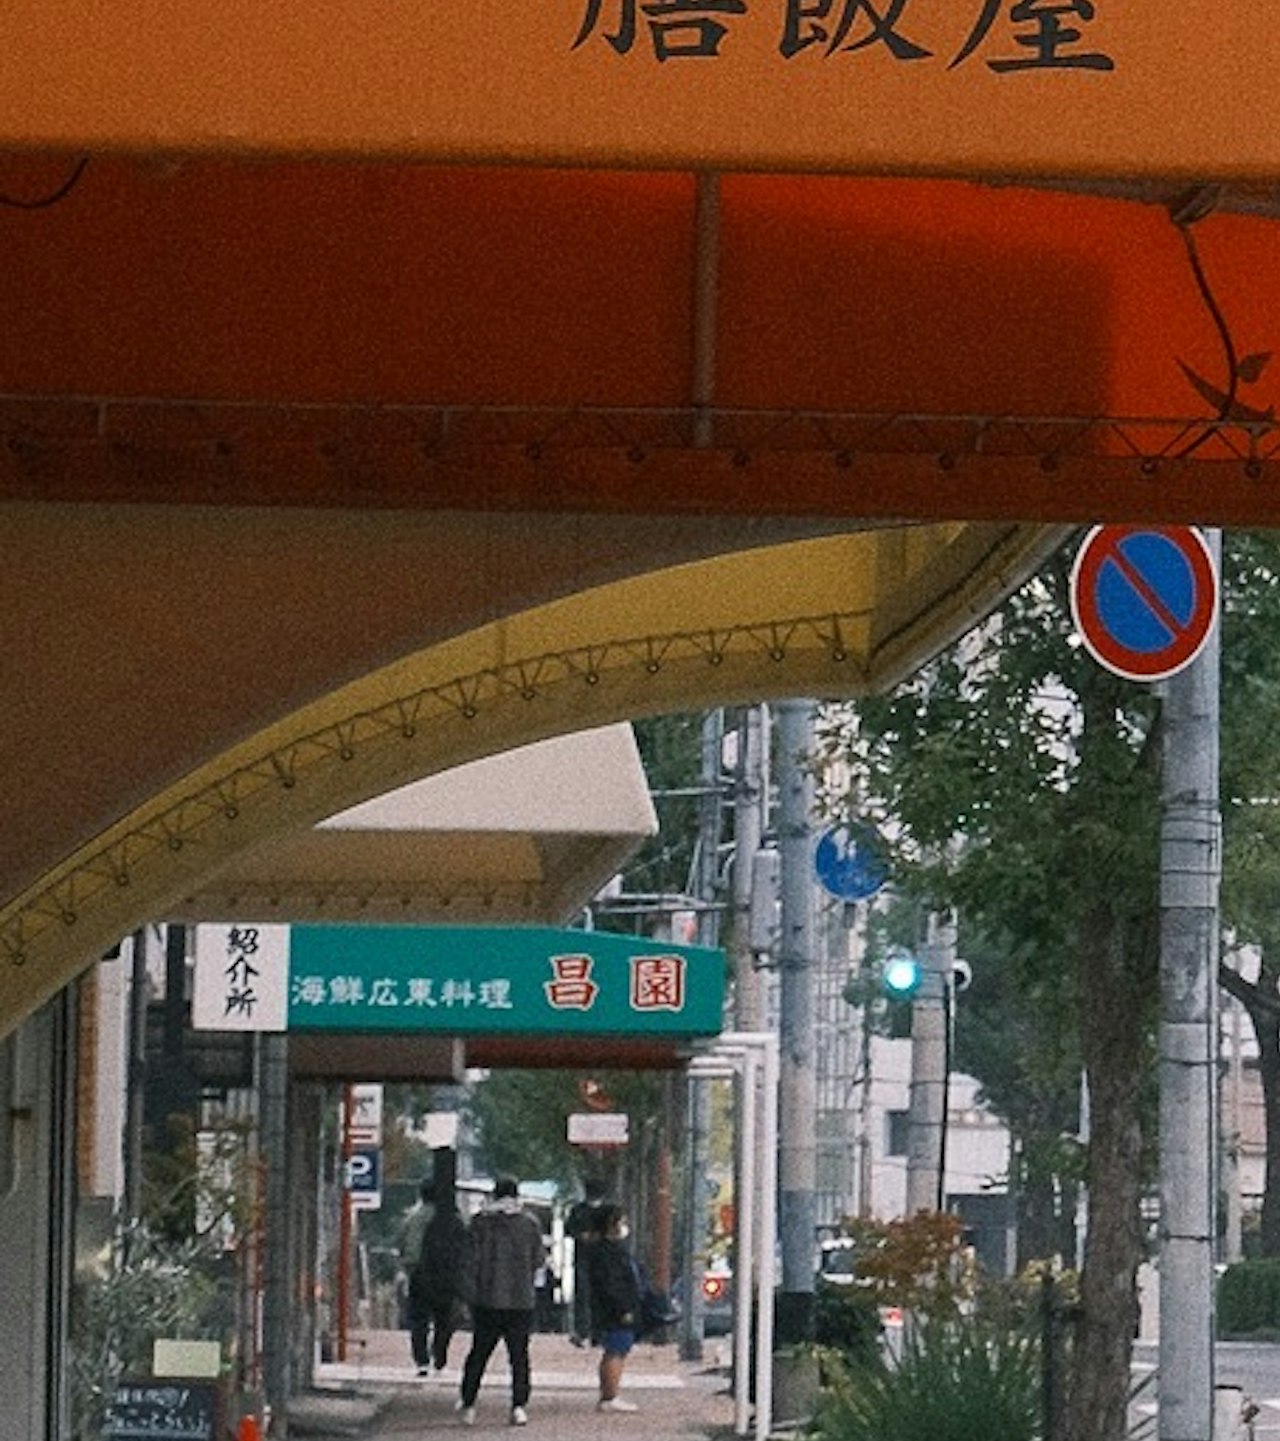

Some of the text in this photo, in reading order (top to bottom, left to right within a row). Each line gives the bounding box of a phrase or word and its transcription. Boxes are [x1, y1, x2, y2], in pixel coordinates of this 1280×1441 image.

[225, 927, 260, 1017] 紹介所
[544, 952, 688, 1013] 昌園
